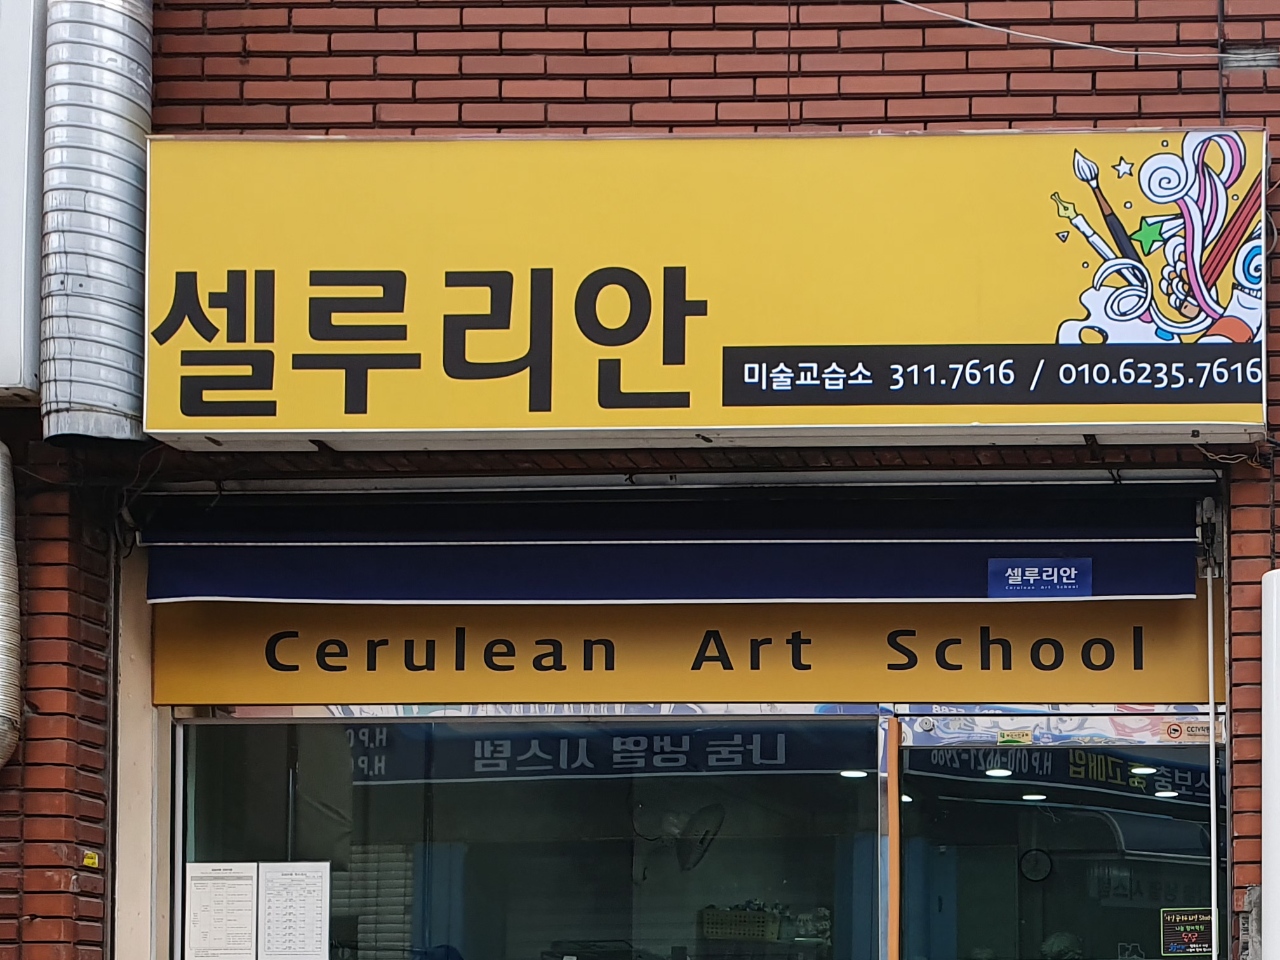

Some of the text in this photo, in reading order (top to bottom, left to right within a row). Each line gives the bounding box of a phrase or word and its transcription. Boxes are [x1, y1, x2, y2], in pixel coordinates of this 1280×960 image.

[149, 266, 707, 417] 셀루리안
[743, 358, 1262, 391] 미술교습소 311.7616 / 010.6235.7616
[1005, 567, 1078, 584] 셀루리안
[264, 626, 1145, 672] Cerulean Art School
